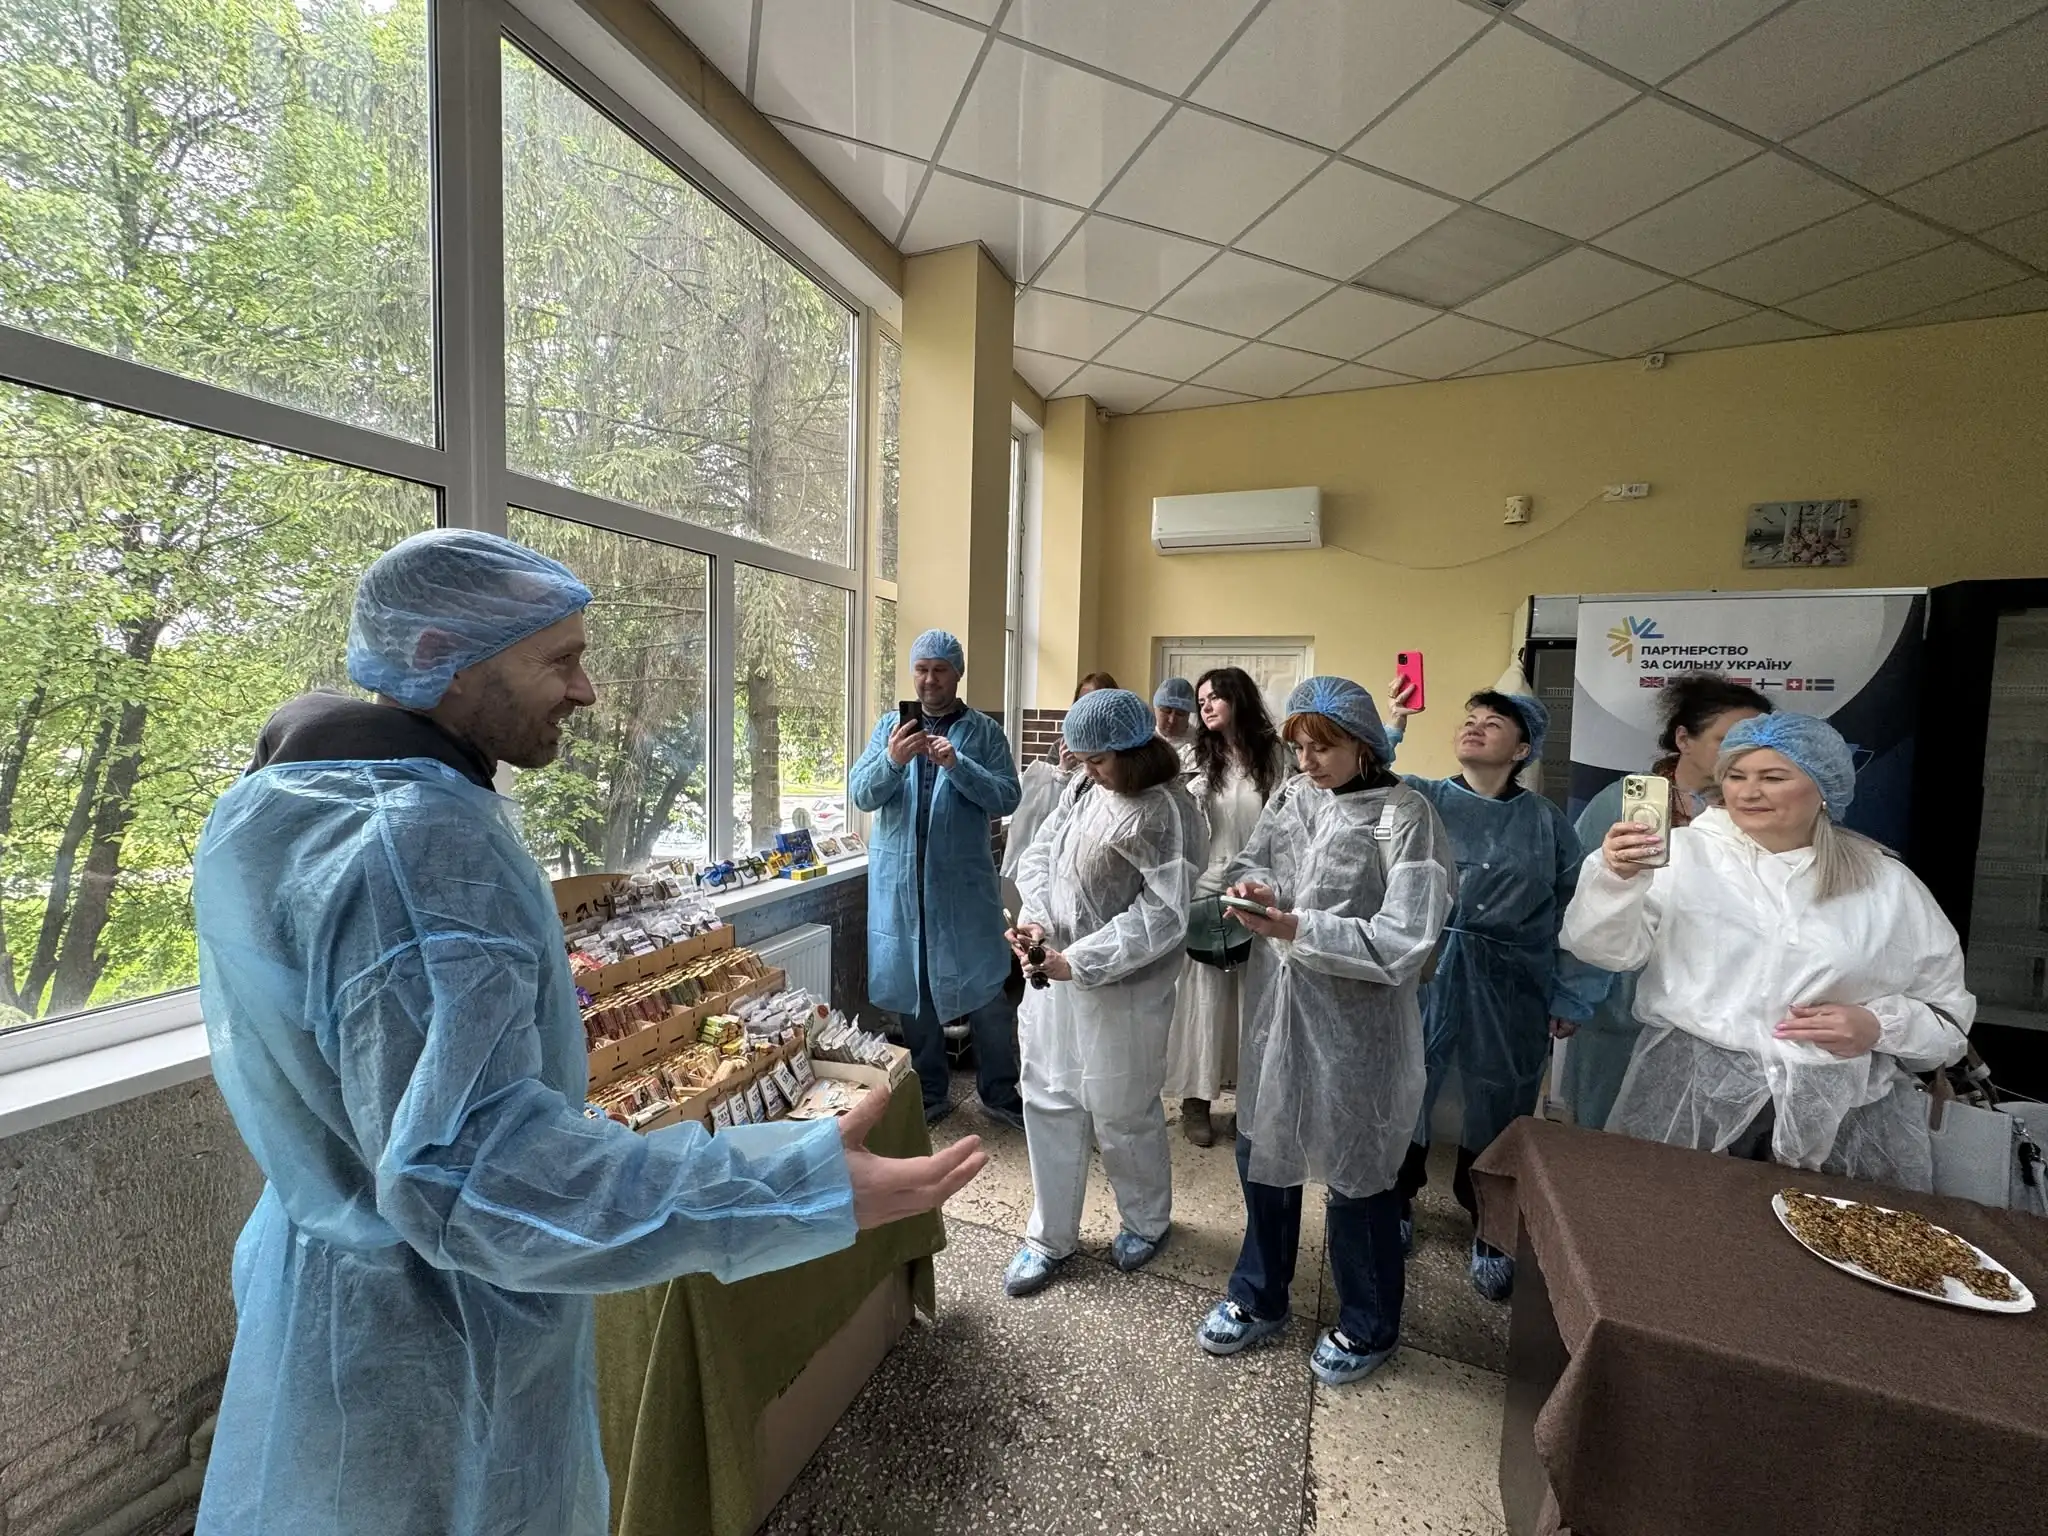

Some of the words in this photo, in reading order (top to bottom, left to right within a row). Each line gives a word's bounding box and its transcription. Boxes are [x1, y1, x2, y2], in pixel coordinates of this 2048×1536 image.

[1641, 645, 1749, 656] ПАРТНЕРСТВО
[1640, 660, 1659, 670] ЗА
[1663, 660, 1724, 671] СИЛЬНУ
[1726, 658, 1792, 671] УКРАЇНУ
